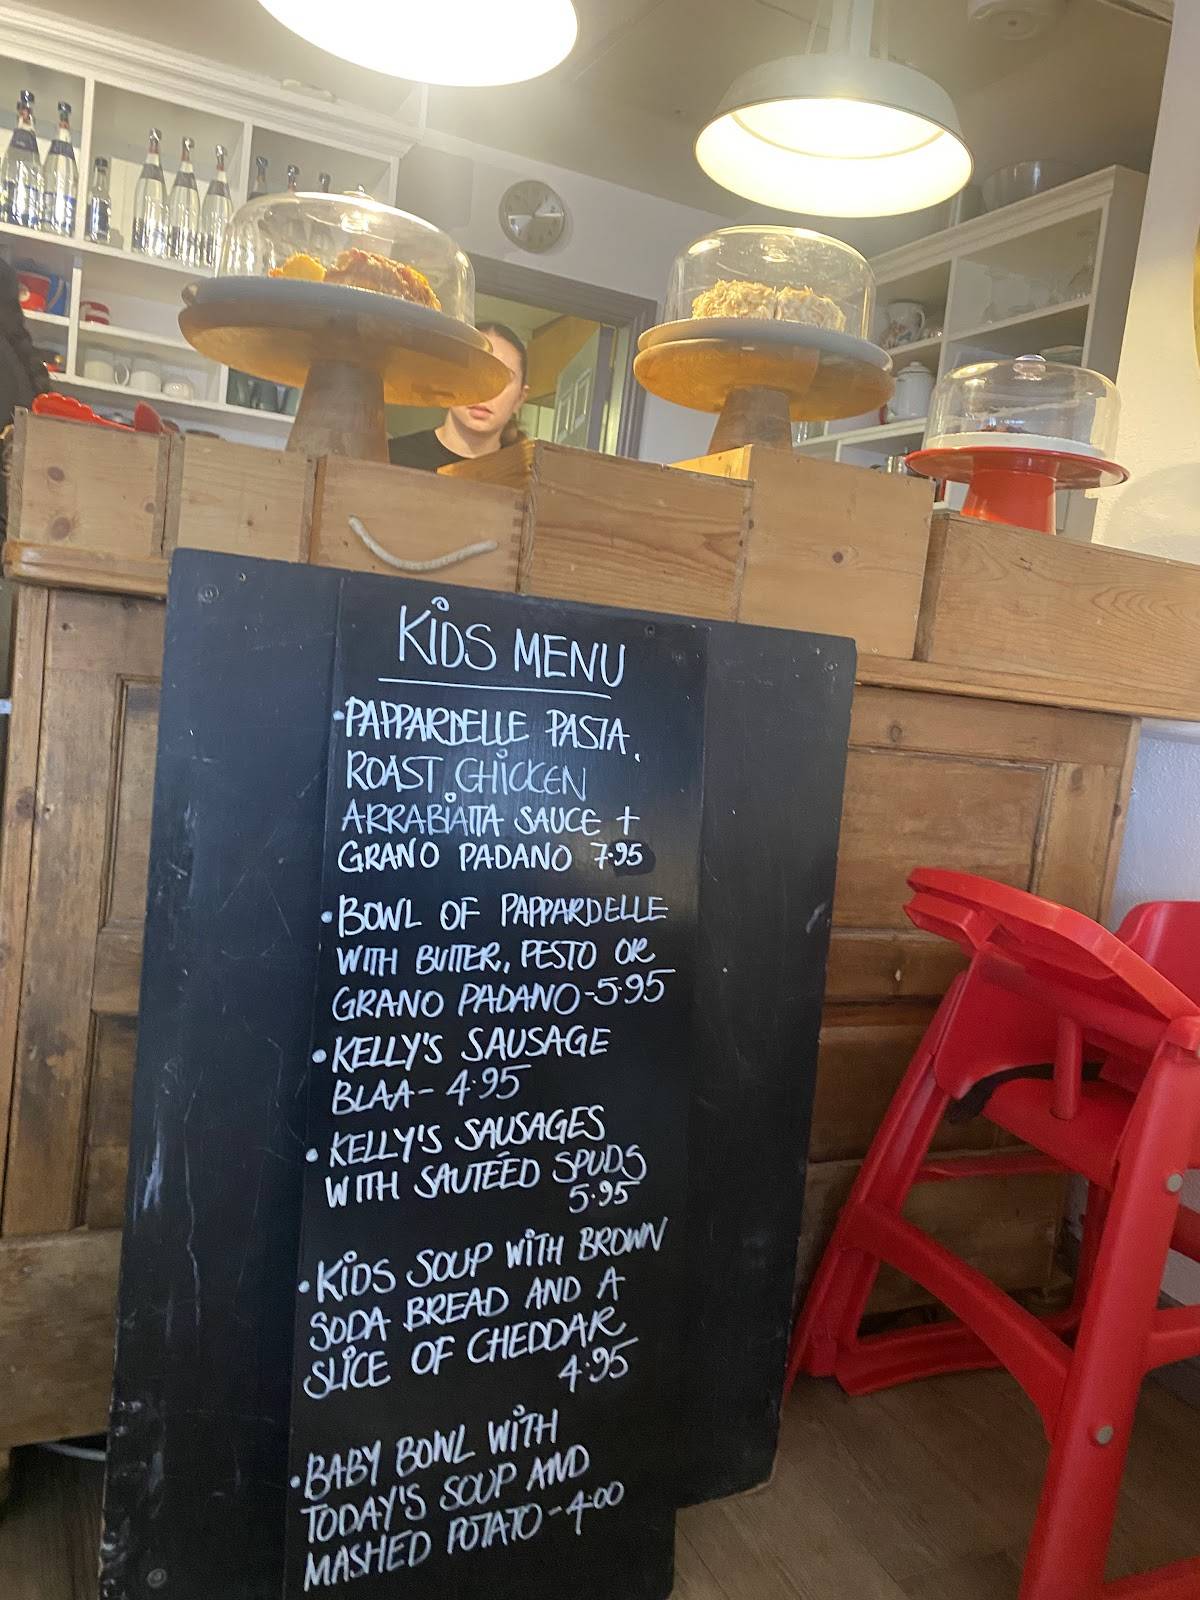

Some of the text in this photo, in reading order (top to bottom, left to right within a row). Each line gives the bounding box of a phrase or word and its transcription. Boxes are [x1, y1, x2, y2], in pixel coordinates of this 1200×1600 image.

[514, 628, 626, 687] MENU
[345, 697, 529, 746] PAPPARDELLE
[346, 750, 444, 793] ROAST
[514, 805, 601, 835] SAUCE
[338, 838, 440, 873] GRANO
[460, 843, 572, 872] PADANO
[338, 893, 668, 937] BOWL OF PAPPARDELLE
[337, 945, 397, 977] WITH
[521, 939, 596, 972] PESTO
[614, 938, 656, 964] OR
[332, 986, 444, 1021] GRANO
[332, 1025, 611, 1073] KELLY'S SAUSAGE
[329, 1105, 605, 1167] KELLY'S SAUSAGES
[325, 1170, 399, 1208] WITH
[552, 1144, 647, 1183] SPUDS
[406, 1242, 493, 1288] SOUP
[578, 1216, 668, 1262] BROWN
[310, 1266, 626, 1352] SODA BREAD AND A
[411, 1336, 455, 1376] OF
[467, 1306, 627, 1363] CHEDDAR
[304, 1440, 381, 1499] BABY
[396, 1424, 475, 1477] BOWL
[301, 1444, 590, 1543] TODAY'S SOUP AND
[304, 1531, 432, 1592] MASHED
